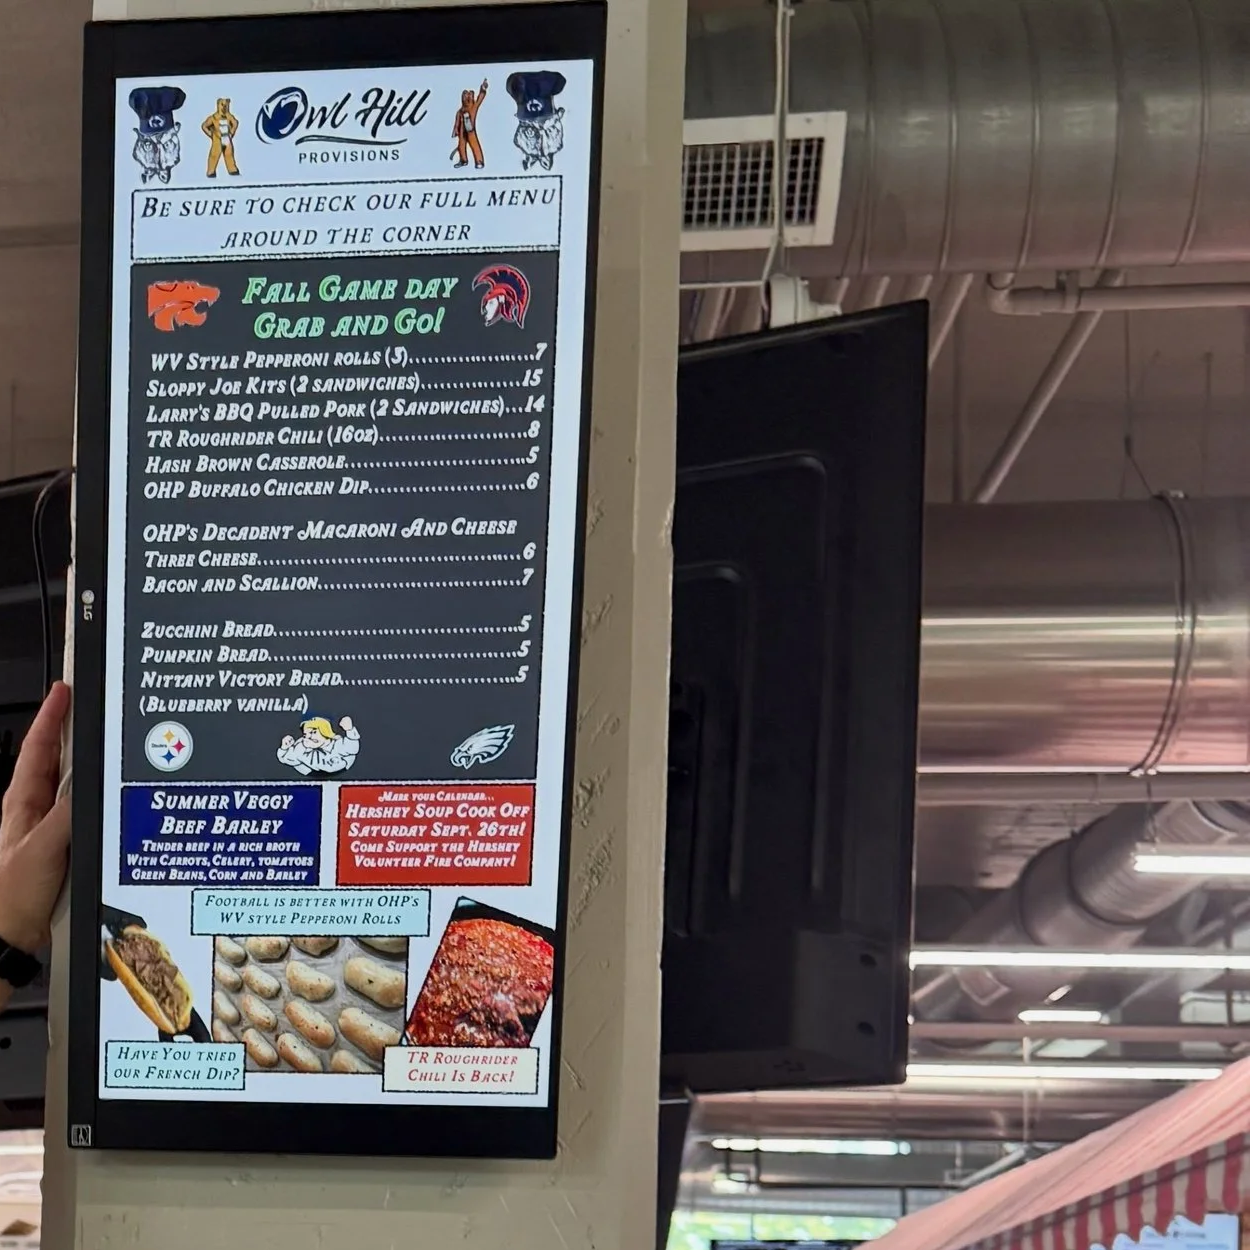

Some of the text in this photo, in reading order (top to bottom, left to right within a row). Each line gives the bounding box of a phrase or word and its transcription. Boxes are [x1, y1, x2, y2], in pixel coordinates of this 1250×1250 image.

[355, 87, 431, 138] Hill
[298, 149, 401, 164] PROVISIONS
[141, 188, 557, 218] BE SURE TO CHECK OUR FULL MENU
[220, 224, 472, 250] AROUND THE CORNER
[242, 275, 459, 305] FALL GAME DAY
[254, 308, 444, 340] GRAB AND GO!
[151, 353, 183, 371] WV
[186, 352, 239, 370] STYLE
[243, 351, 329, 369] PEPPERONI
[334, 351, 381, 366] ROLLS
[146, 379, 206, 397] SLOPPY
[210, 377, 242, 395] JOE
[246, 376, 286, 394] KITS
[290, 375, 309, 396] (2
[146, 404, 210, 423] LARRY'S
[214, 403, 254, 422] BBQ
[257, 402, 320, 420] PULLED
[324, 400, 367, 418] PORK
[370, 399, 389, 420] (2
[147, 427, 324, 448] TR ROUGHRIDER CHILI
[145, 456, 191, 473] HASH
[196, 455, 253, 472] BROWN
[144, 481, 184, 499] OHP
[188, 481, 260, 498] BUFFALO
[264, 479, 335, 496] CHICKEN
[143, 517, 517, 542] OHP'S DECADENT MACARONI AND CHEESE
[144, 551, 195, 568] THREE
[142, 576, 198, 594] BACON
[201, 579, 236, 592] AND
[141, 622, 218, 639] ZUCCHINI
[141, 646, 213, 664] PUMPKIN
[140, 671, 214, 689] NITTANY
[219, 670, 285, 687] VICTORY
[139, 694, 308, 716] (BLUEBERRY VANILLA)
[151, 791, 293, 810] SUMMER VEGGY
[345, 803, 530, 818] HERSHEY SOUP COOK OFF
[160, 815, 283, 835] BEEF BARLEY
[348, 823, 427, 837] SATURDAY
[142, 840, 300, 852] TENDER BEEF IN A RICH BROTH
[350, 840, 520, 852] COME SUPPORT THE HERSHEY
[127, 854, 157, 866] WITH
[258, 857, 314, 866] TOMATOES
[354, 855, 420, 867] VOLUNTEER
[424, 855, 450, 867] FIRE
[131, 869, 165, 880] GREEN
[208, 869, 237, 881] CORN
[240, 871, 263, 880] AND
[266, 869, 308, 881] BARLEY
[205, 895, 419, 907] FOOTBALL IS BETTER WITH OHP'S
[220, 912, 401, 924] WV STYLE PEPPERONI ROLLS
[118, 1047, 236, 1061] HAVE YOU TRIED
[408, 1051, 518, 1064] TR ROUGHRIDER
[114, 1066, 239, 1080] OUR FRENCH DIP?
[408, 1069, 514, 1083] CHILI IS BACK!
